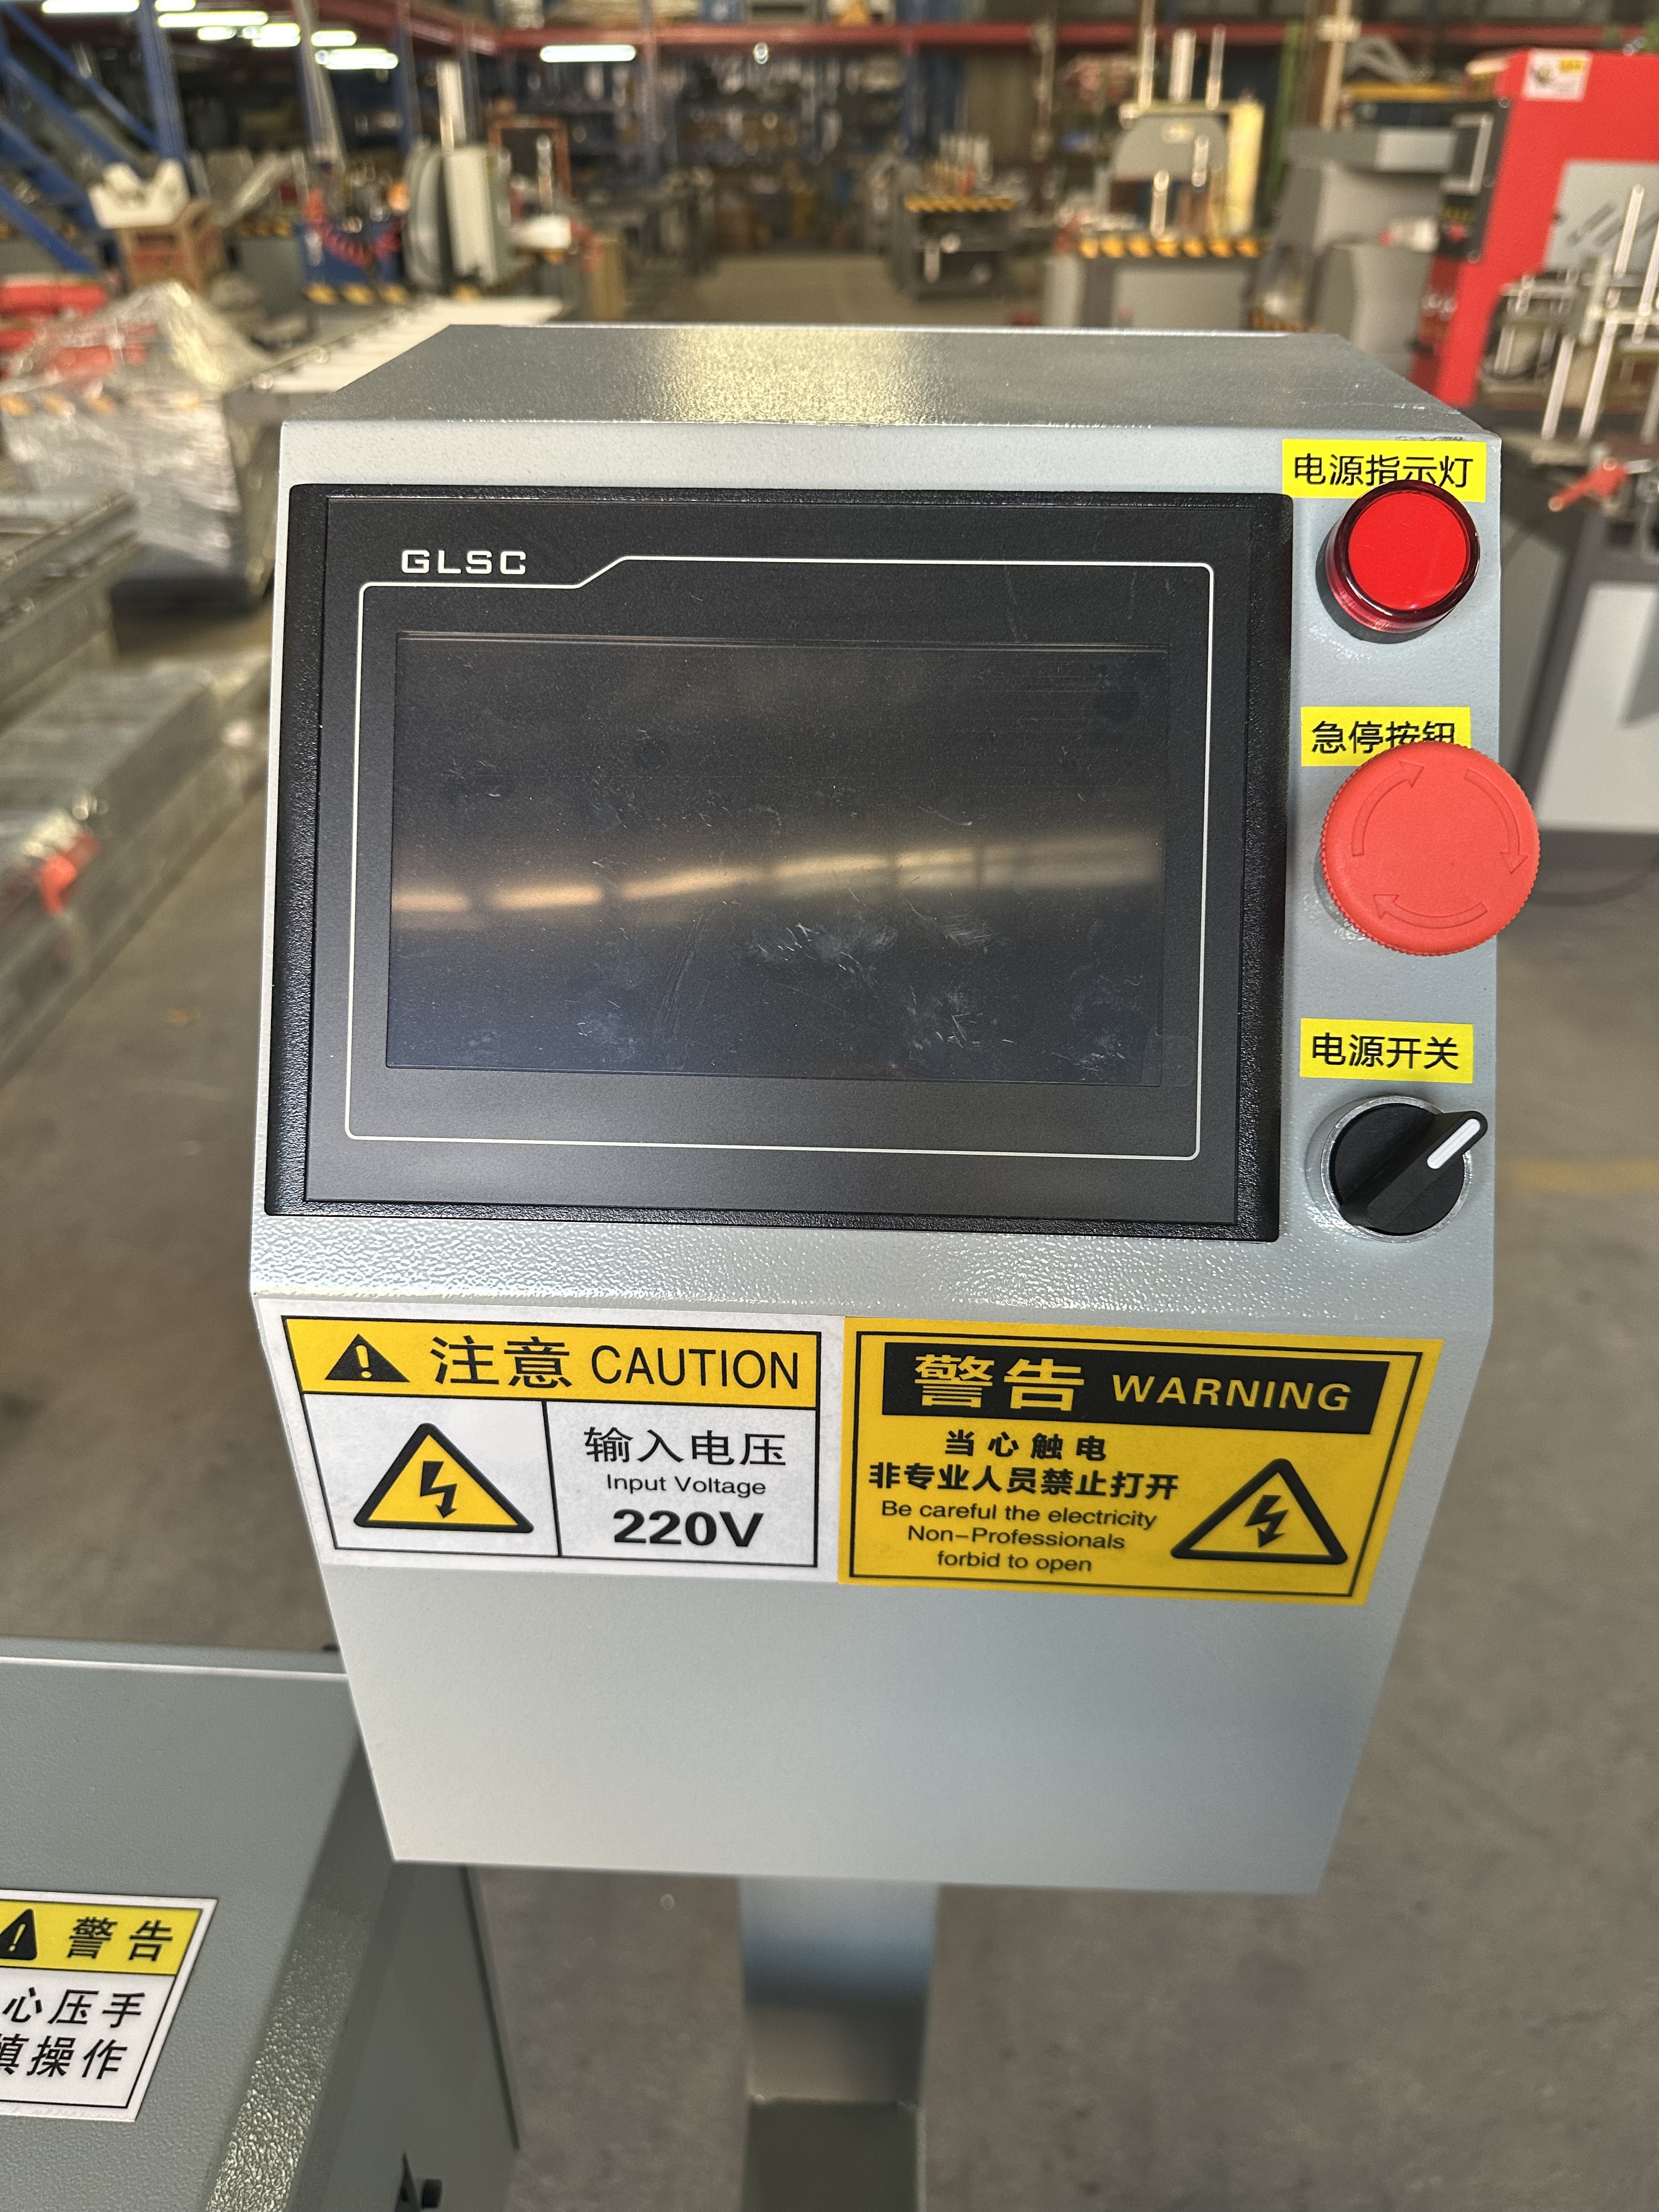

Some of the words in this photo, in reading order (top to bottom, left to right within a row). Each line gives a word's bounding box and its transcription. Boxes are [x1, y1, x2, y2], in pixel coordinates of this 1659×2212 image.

[1294, 453, 1474, 488] 电源指示灯
[402, 549, 526, 574] GLSC
[1312, 1032, 1459, 1070] 电源开关
[430, 1335, 573, 1389] 注意
[591, 1345, 799, 1390] CAUTION
[914, 1353, 1085, 1412] 警告
[1111, 1374, 1352, 1411] WARNING
[584, 1426, 786, 1466] 输入电压
[944, 1429, 1107, 1462] 当心触电
[607, 1473, 667, 1494] Input
[674, 1476, 766, 1498] Voltage
[868, 1462, 1179, 1501] 非专业人员禁止打开
[613, 1509, 765, 1548] 220V
[882, 1500, 912, 1517] Be
[919, 1500, 997, 1521] careful
[1005, 1504, 1041, 1522] the
[1047, 1506, 1158, 1531] electricity
[937, 1550, 1001, 1568] forbid
[1007, 1554, 1029, 1569] to
[1035, 1558, 1092, 1575] open
[67, 1916, 173, 1962] 警告
